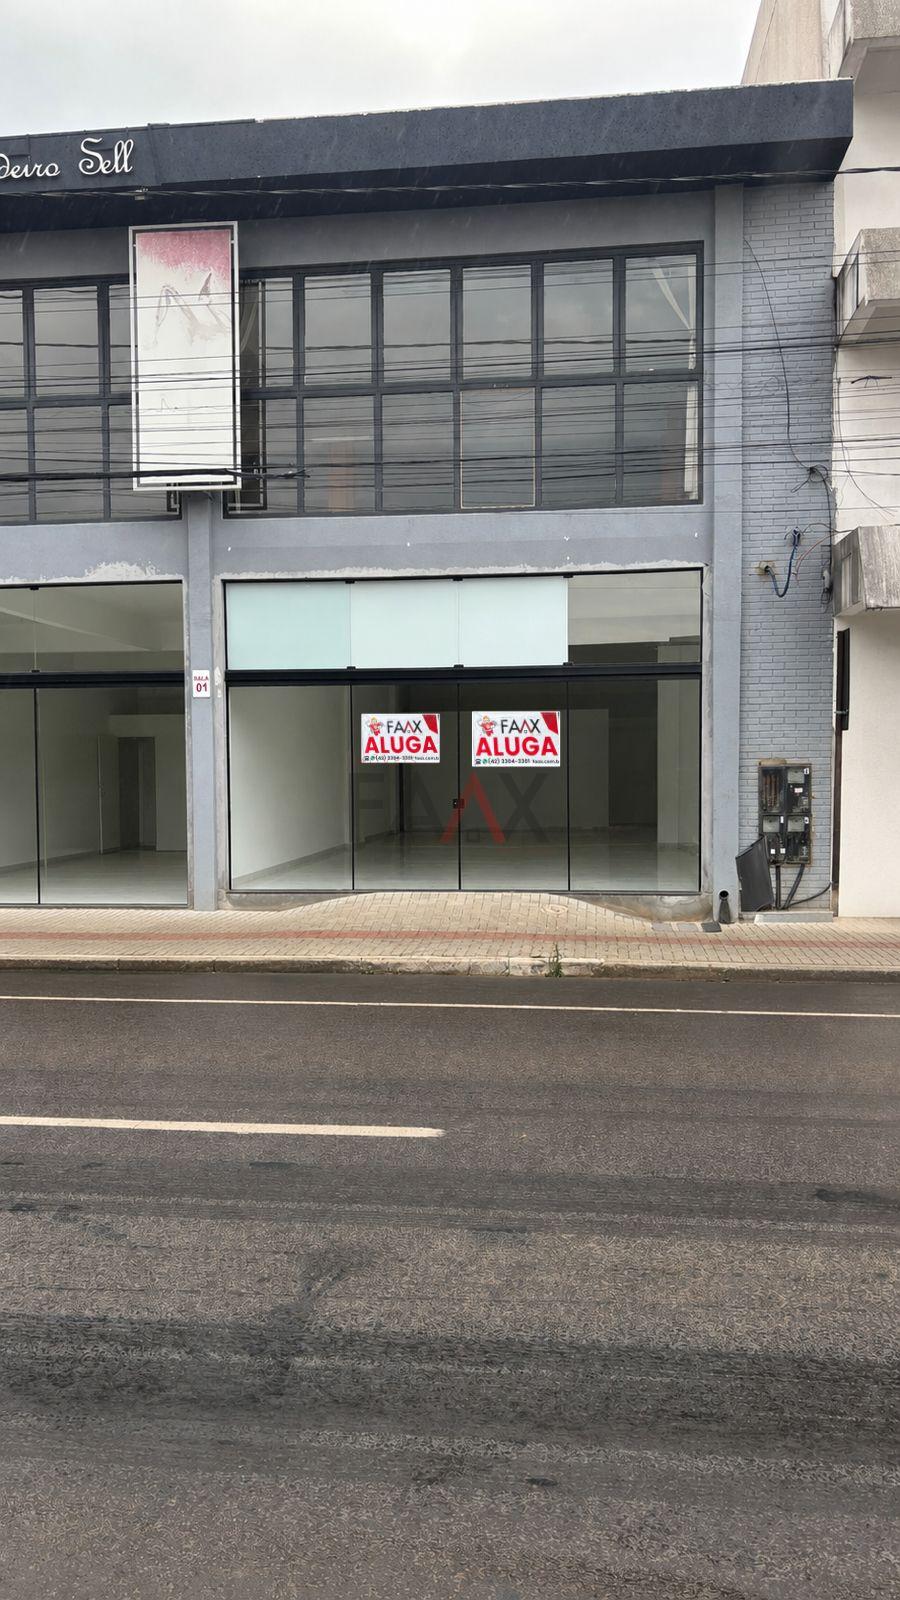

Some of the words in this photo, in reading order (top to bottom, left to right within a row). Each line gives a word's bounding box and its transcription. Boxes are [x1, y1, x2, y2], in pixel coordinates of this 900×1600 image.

[79, 137, 133, 175] Sell
[196, 682, 208, 692] 01
[364, 736, 438, 754] ALUGA
[475, 736, 558, 756] ALUGA
